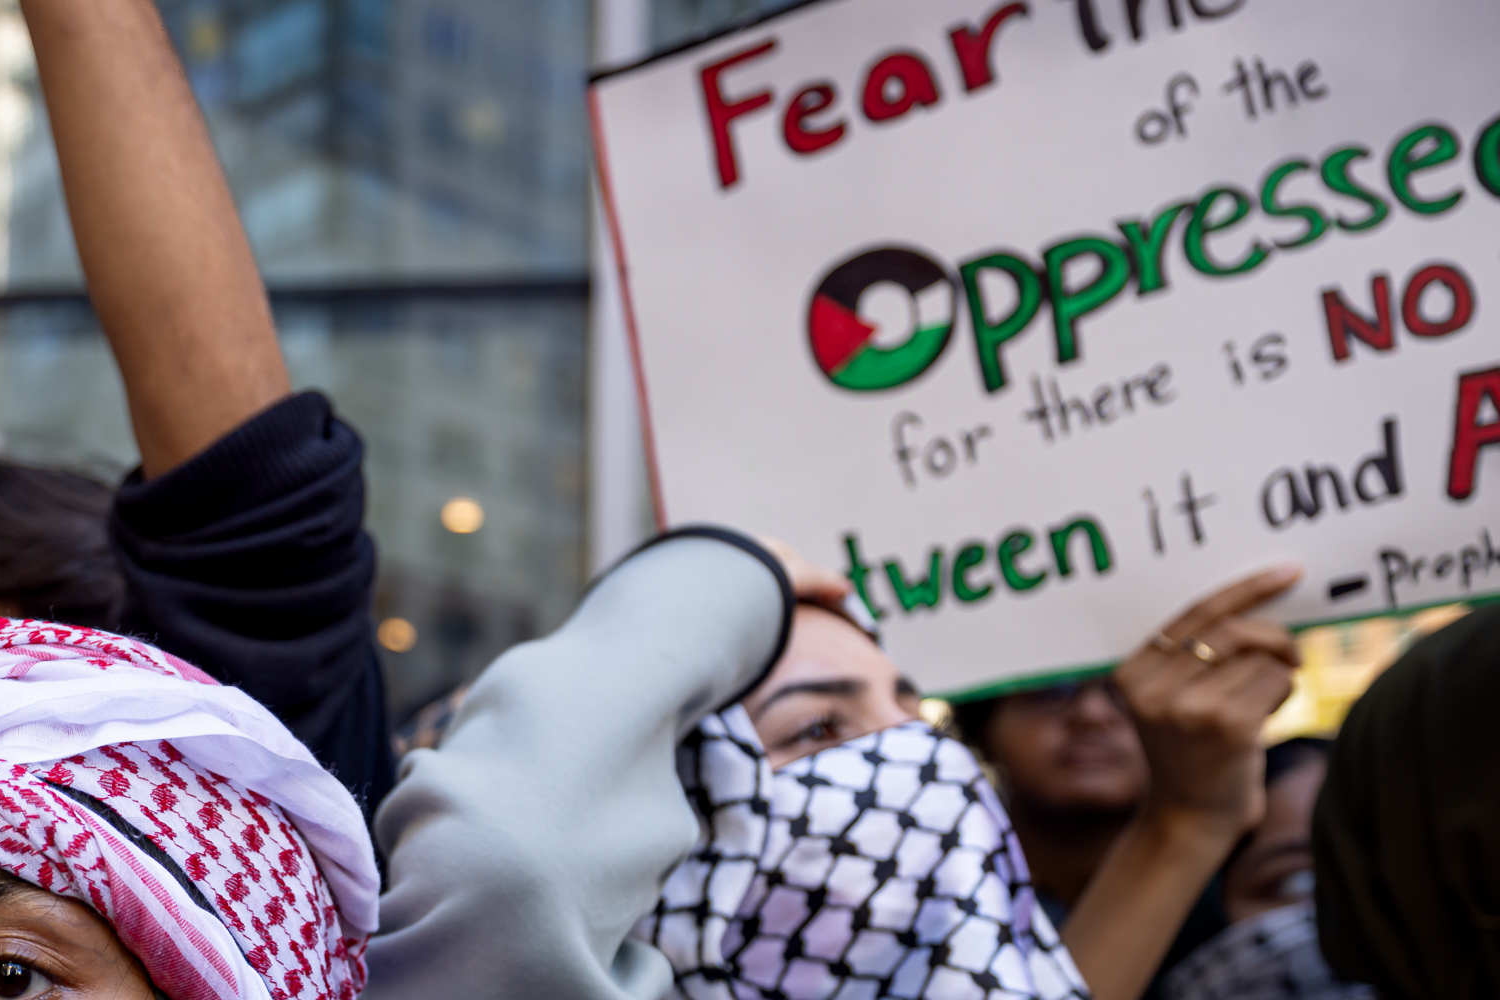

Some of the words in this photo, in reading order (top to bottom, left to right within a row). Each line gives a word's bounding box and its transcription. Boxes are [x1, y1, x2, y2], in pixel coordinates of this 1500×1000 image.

[699, 3, 1030, 191] Fear
[1134, 71, 1200, 145] of
[1222, 55, 1328, 121] the
[891, 409, 993, 490] for
[1022, 362, 1178, 445] there
[1223, 332, 1289, 386] is
[1320, 264, 1476, 363] NO
[1142, 474, 1218, 554] it
[1262, 416, 1404, 530] and
